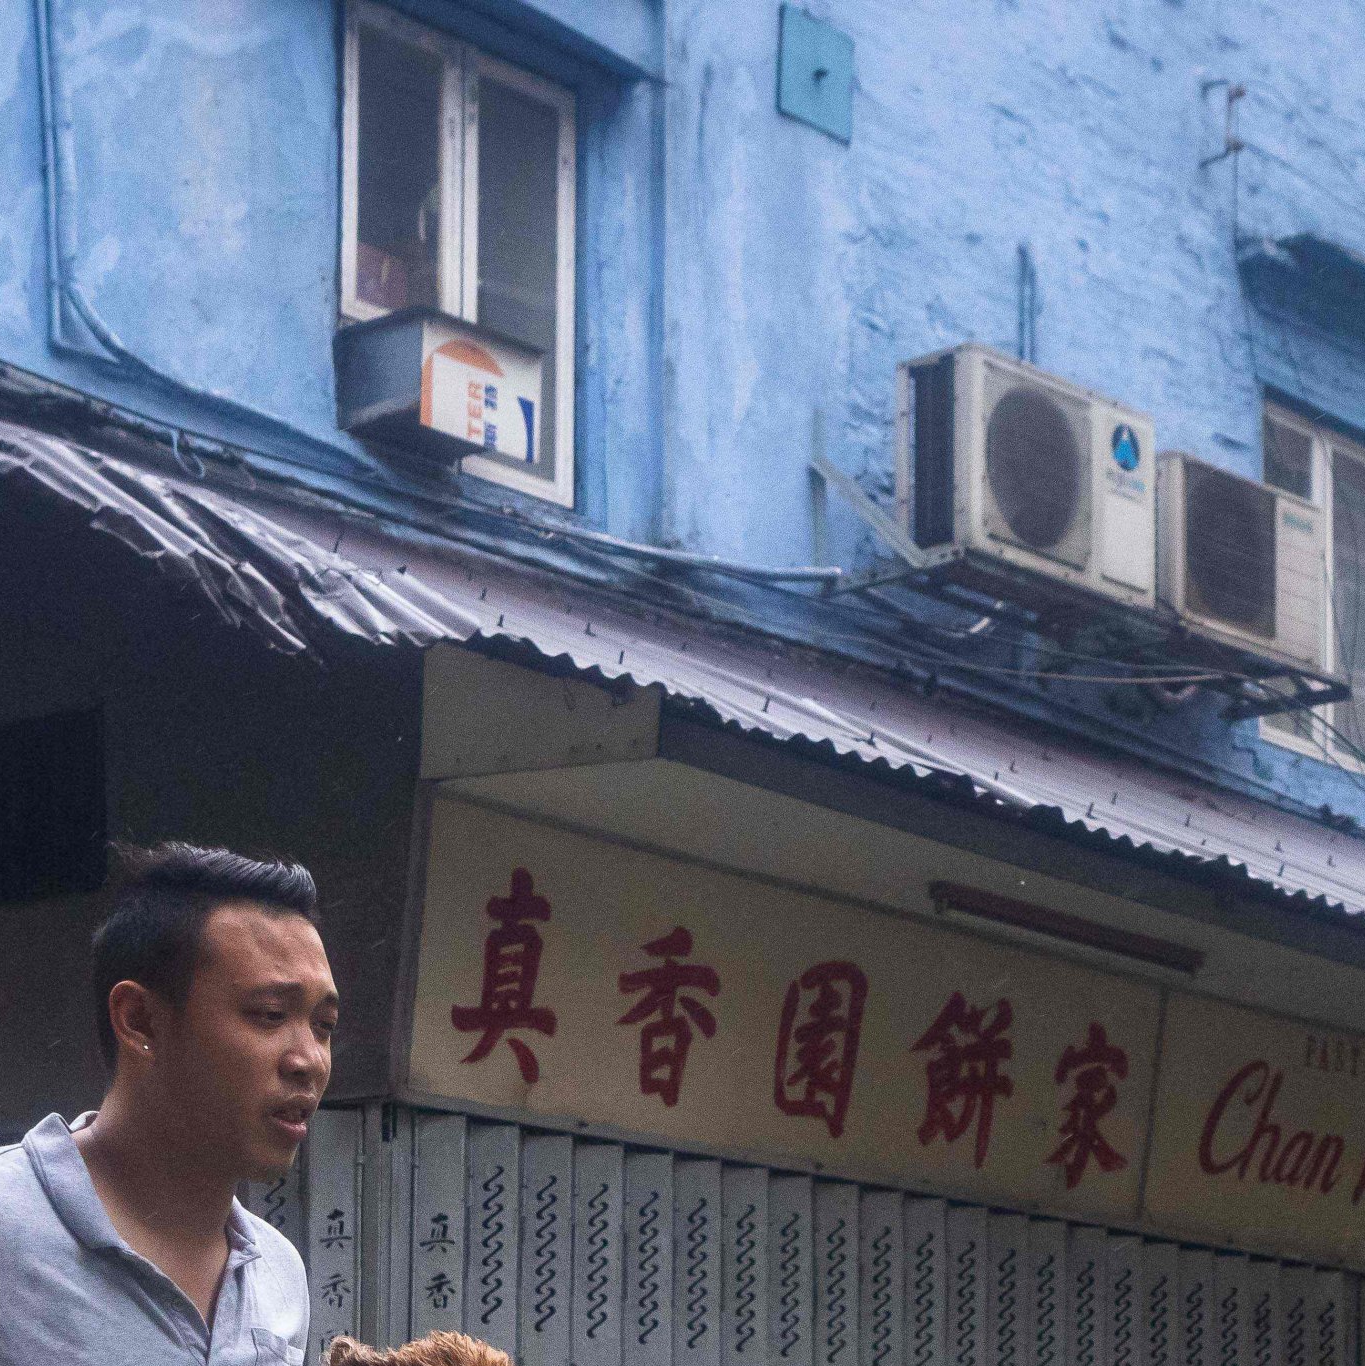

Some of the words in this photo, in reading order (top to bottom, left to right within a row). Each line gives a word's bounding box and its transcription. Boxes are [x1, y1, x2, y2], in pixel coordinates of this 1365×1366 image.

[451, 866, 1128, 1189] 真香園餅家
[1198, 1060, 1345, 1194] Chan
